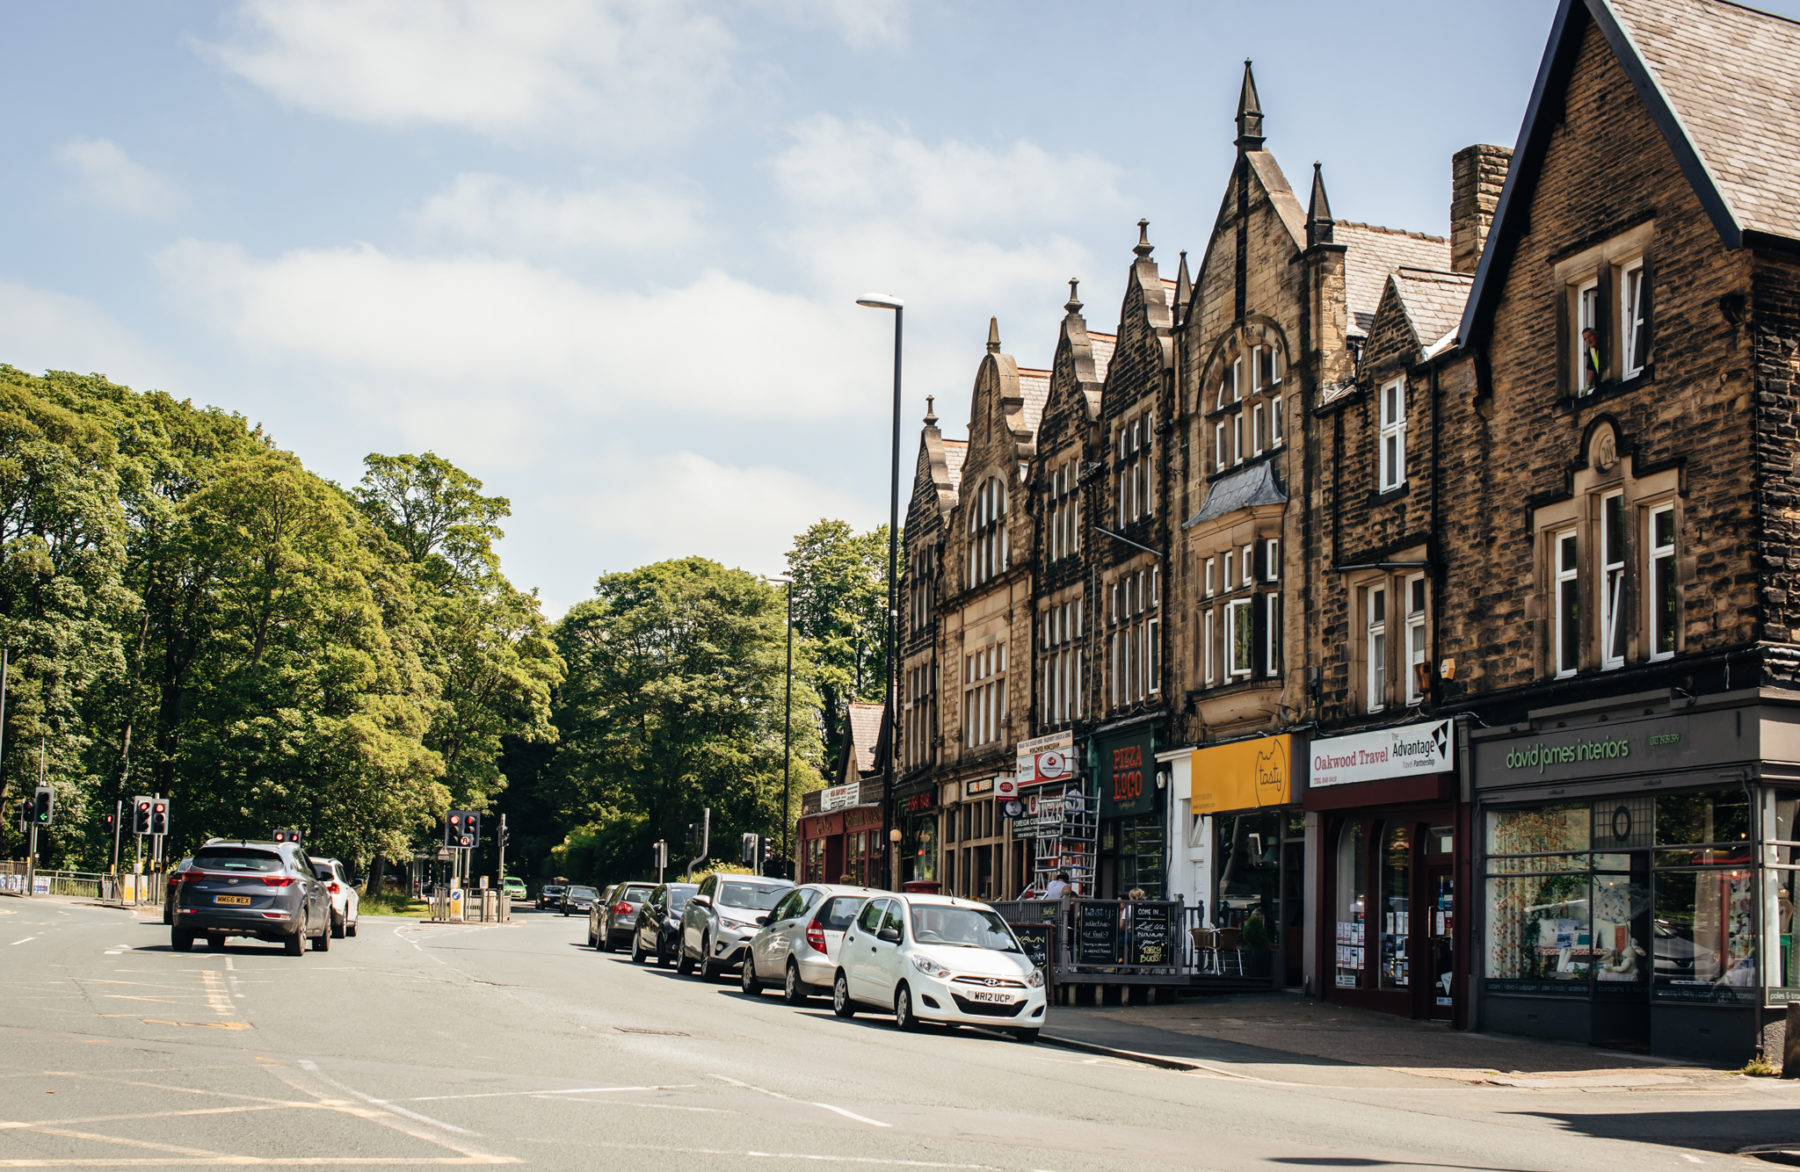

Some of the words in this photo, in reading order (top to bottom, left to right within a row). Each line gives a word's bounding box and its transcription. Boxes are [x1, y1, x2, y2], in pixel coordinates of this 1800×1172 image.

[1112, 745, 1142, 770] PIZZA
[1314, 751, 1357, 771] Oakwood
[1358, 746, 1389, 766] Travel
[1392, 740, 1435, 758] Advantage
[1506, 743, 1539, 769] david
[1539, 743, 1575, 774] james
[1577, 735, 1629, 761] interiors
[1413, 758, 1435, 767] Partnership
[1259, 761, 1282, 792] tasty
[994, 993, 1011, 1002] UCP
